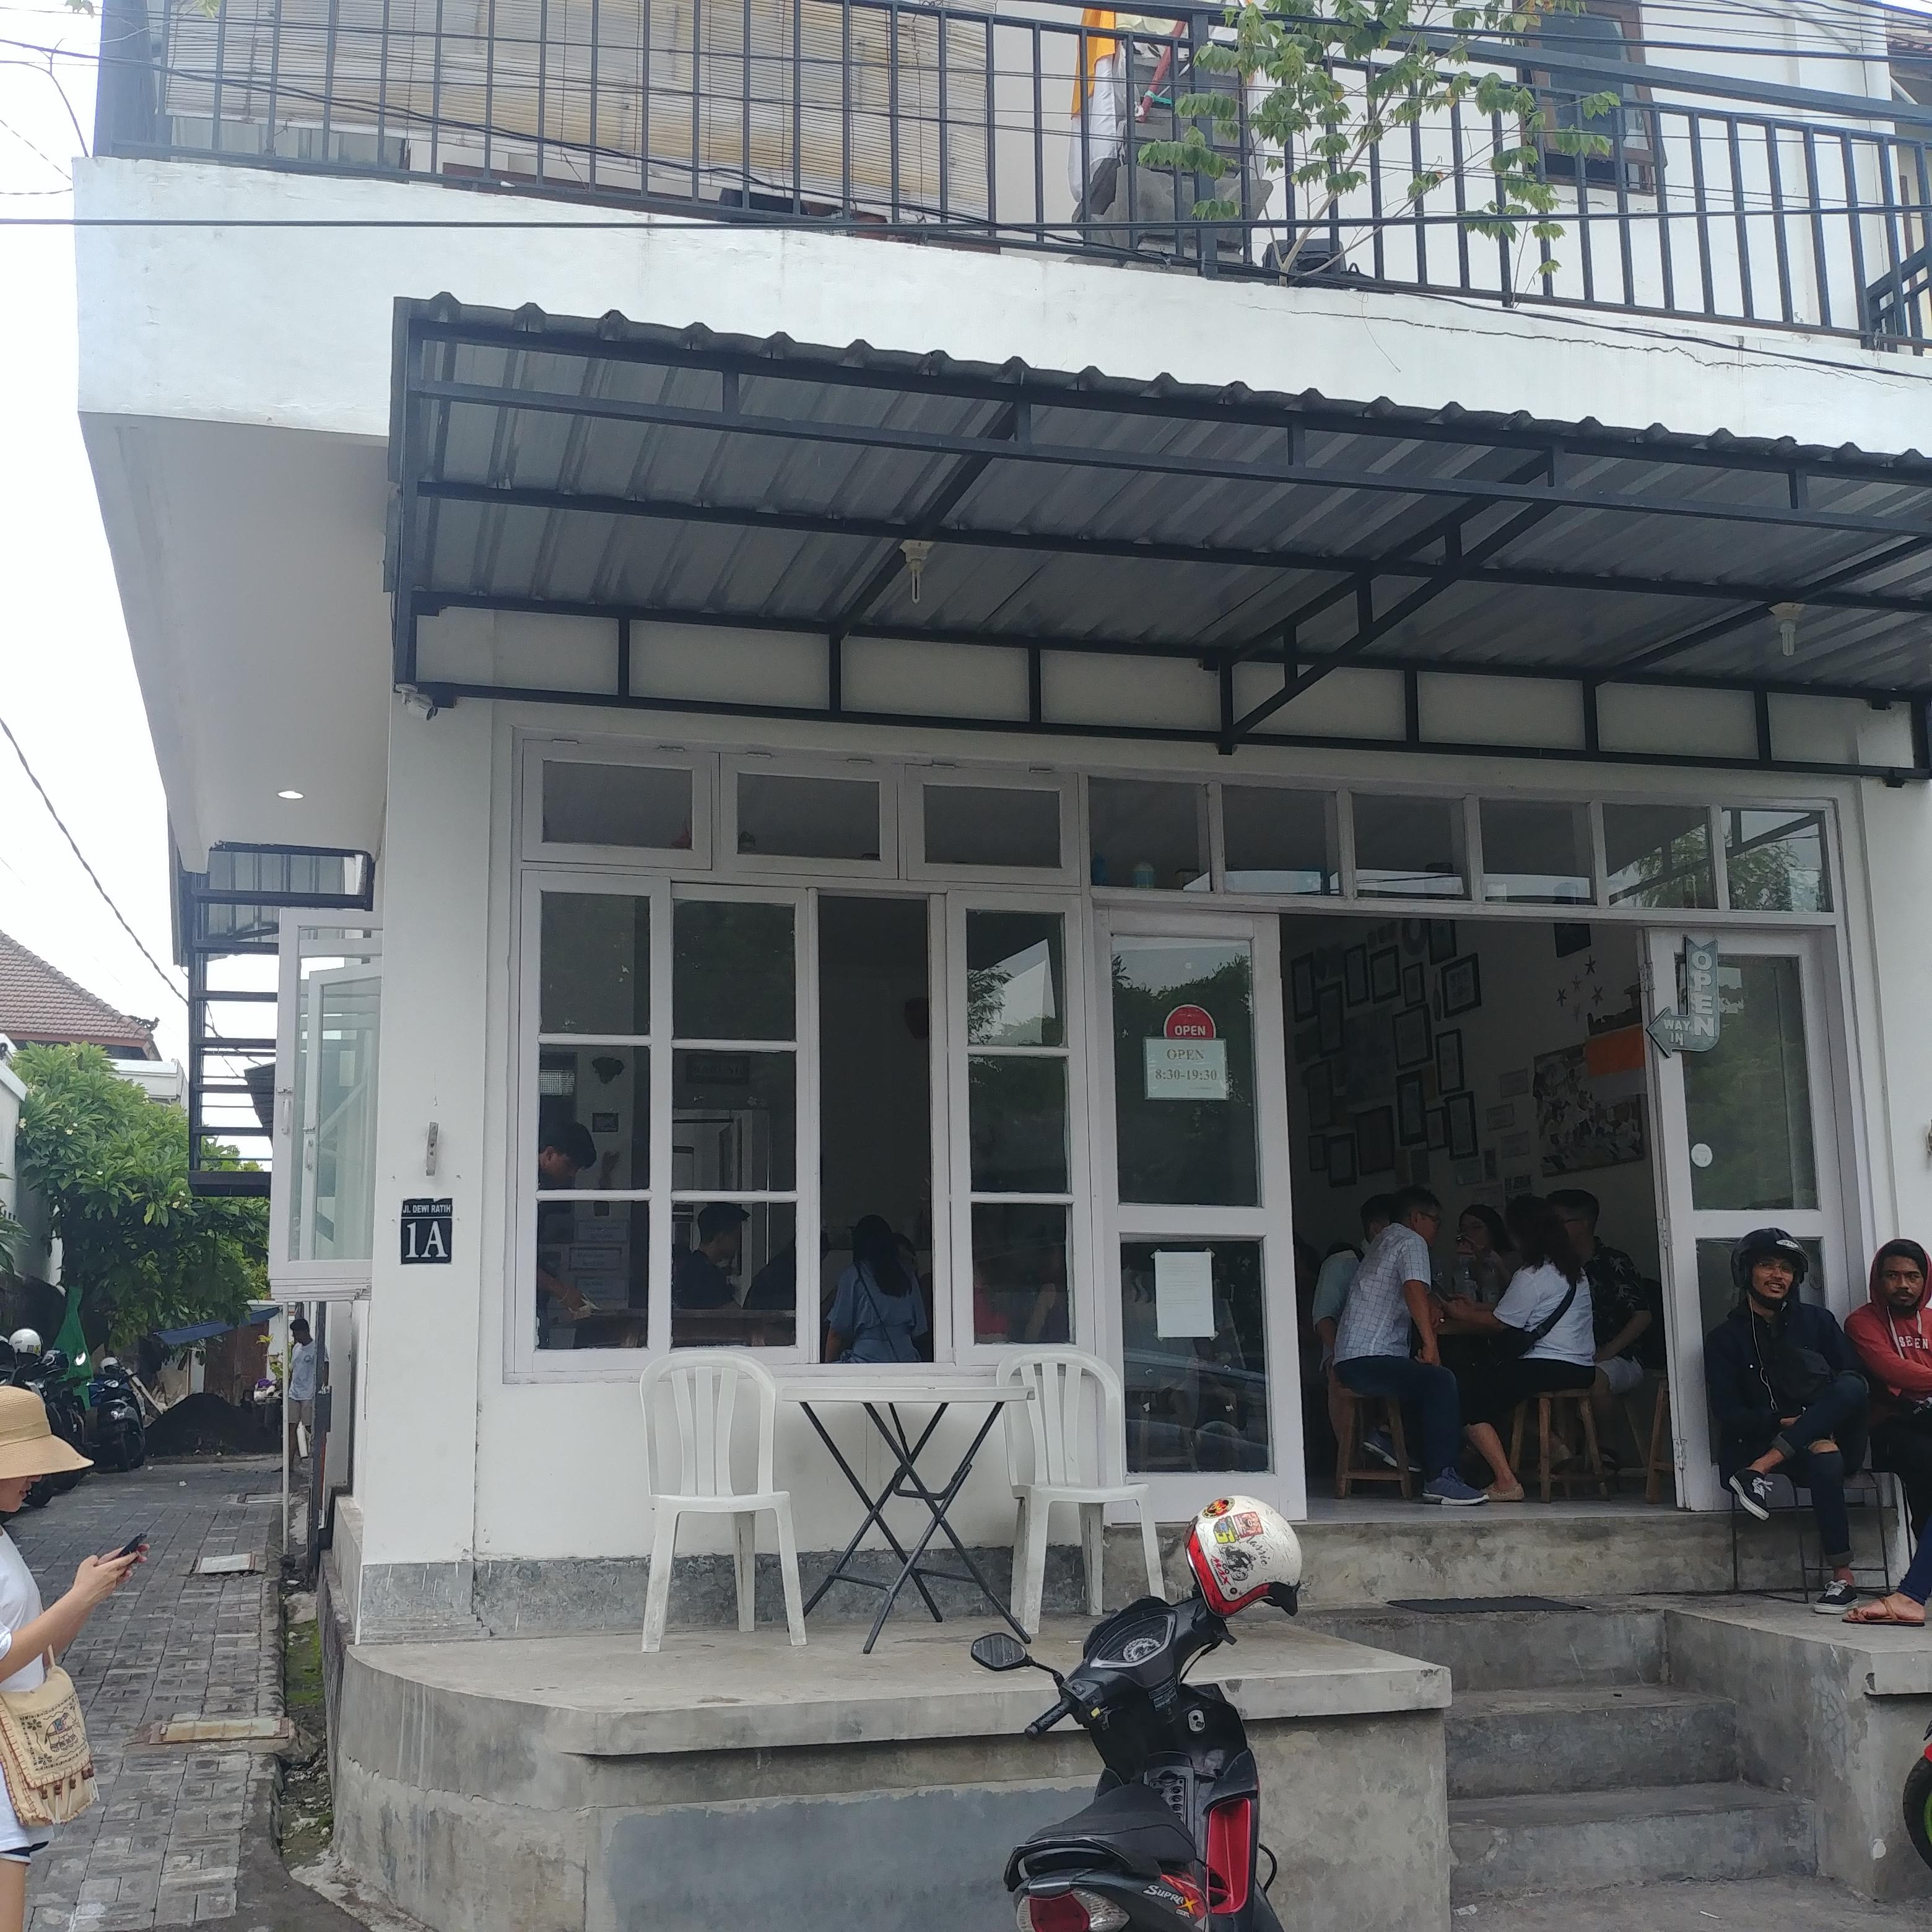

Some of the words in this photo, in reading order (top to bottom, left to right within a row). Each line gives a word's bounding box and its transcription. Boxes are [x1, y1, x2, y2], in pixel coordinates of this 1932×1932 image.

[1691, 951, 1715, 1038] OPEN
[1174, 1025, 1206, 1036] OPEN
[1663, 1019, 1691, 1032] WAY
[1670, 1033, 1684, 1046] IN
[1166, 1049, 1204, 1060] OPEN
[1155, 1069, 1217, 1081] 8:30-19:30
[412, 1204, 430, 1214] DEWI
[431, 1204, 451, 1214] RATIH
[405, 1221, 448, 1258] 1A
[1899, 1336, 1929, 1349] SEEN
[1142, 1885, 1184, 1905] SUPRA
